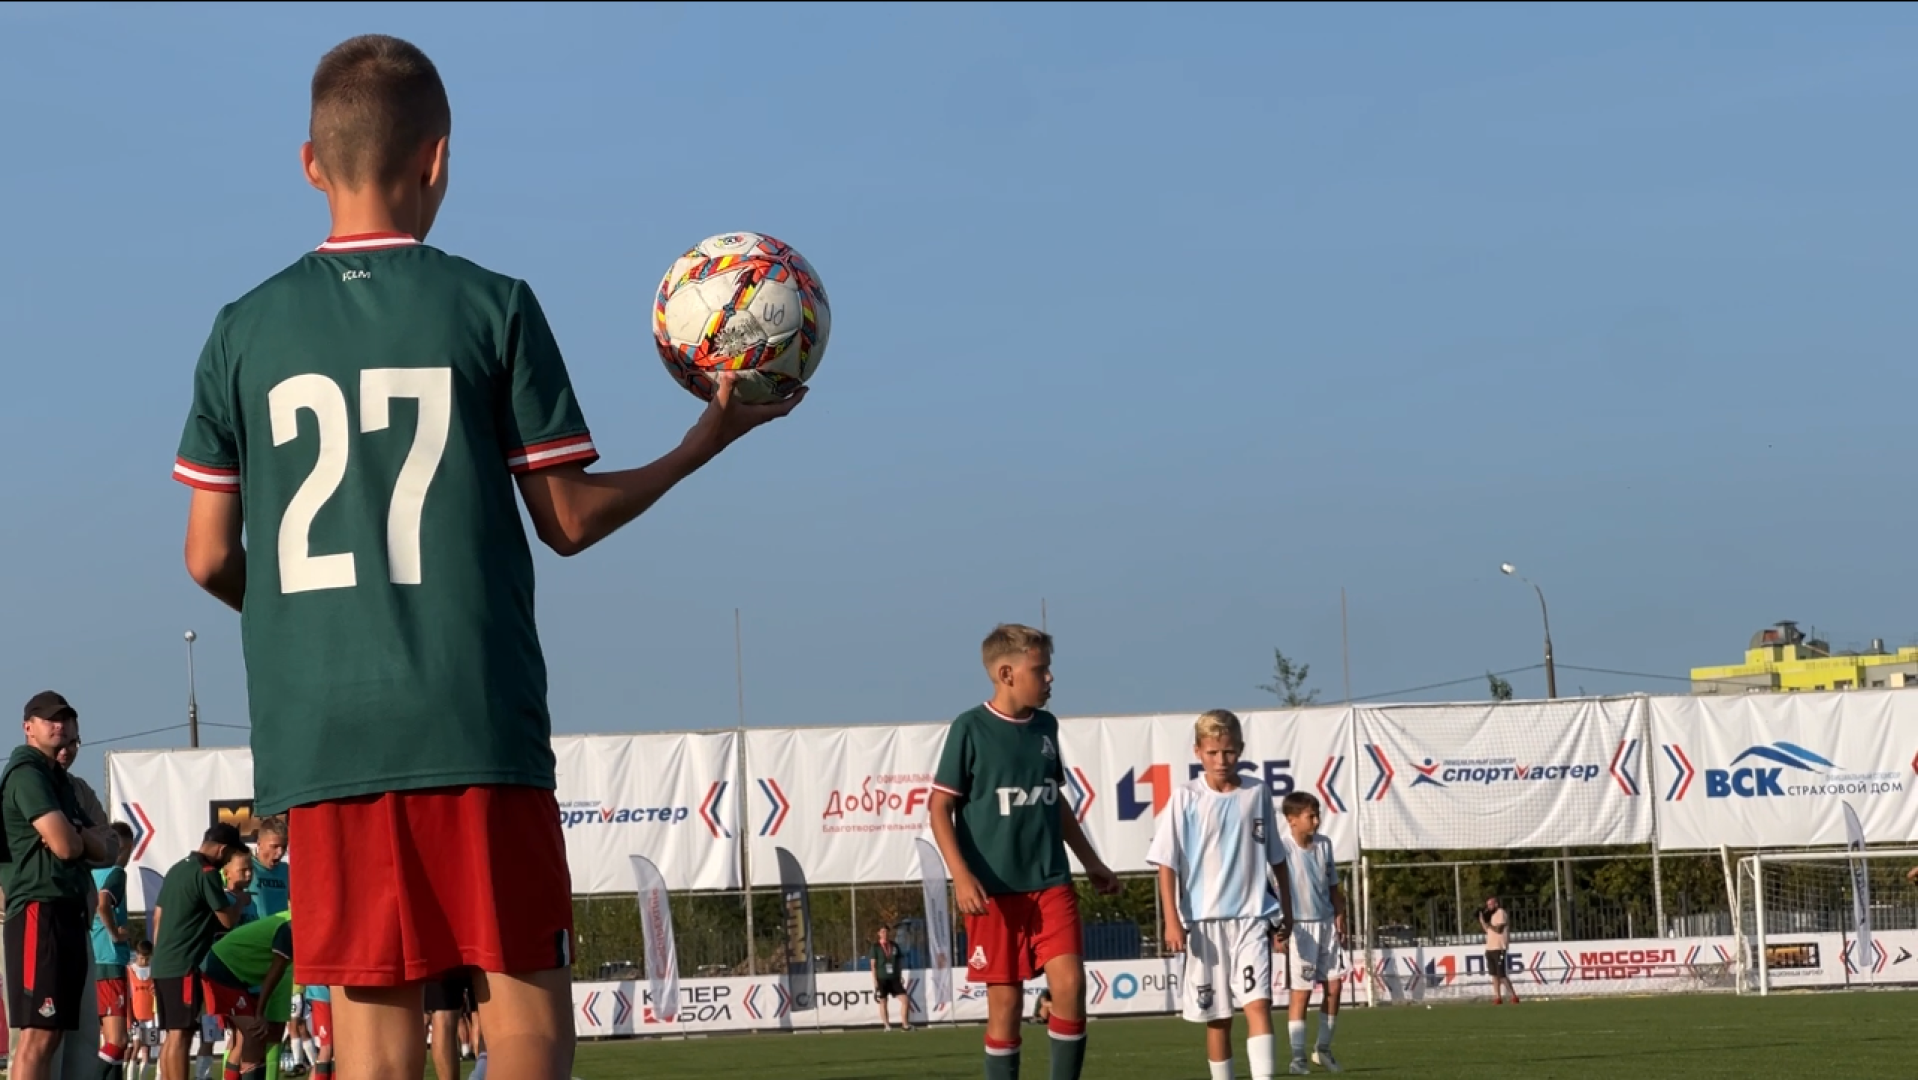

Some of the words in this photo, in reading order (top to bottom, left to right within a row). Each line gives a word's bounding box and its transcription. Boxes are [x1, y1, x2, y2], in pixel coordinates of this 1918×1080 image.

[268, 367, 452, 594] 27
[1705, 768, 1785, 798] ВСК
[1787, 781, 1867, 796] СТРАХОВОЙ
[1870, 782, 1903, 794] ДОМ
[823, 775, 931, 819] ДоброF
[560, 806, 688, 828] ортмастер
[1465, 953, 1525, 976] ПБ
[1580, 949, 1676, 965] МОСОБЛ
[1582, 966, 1655, 980] СПОРТ
[643, 986, 731, 1005] КПЕР
